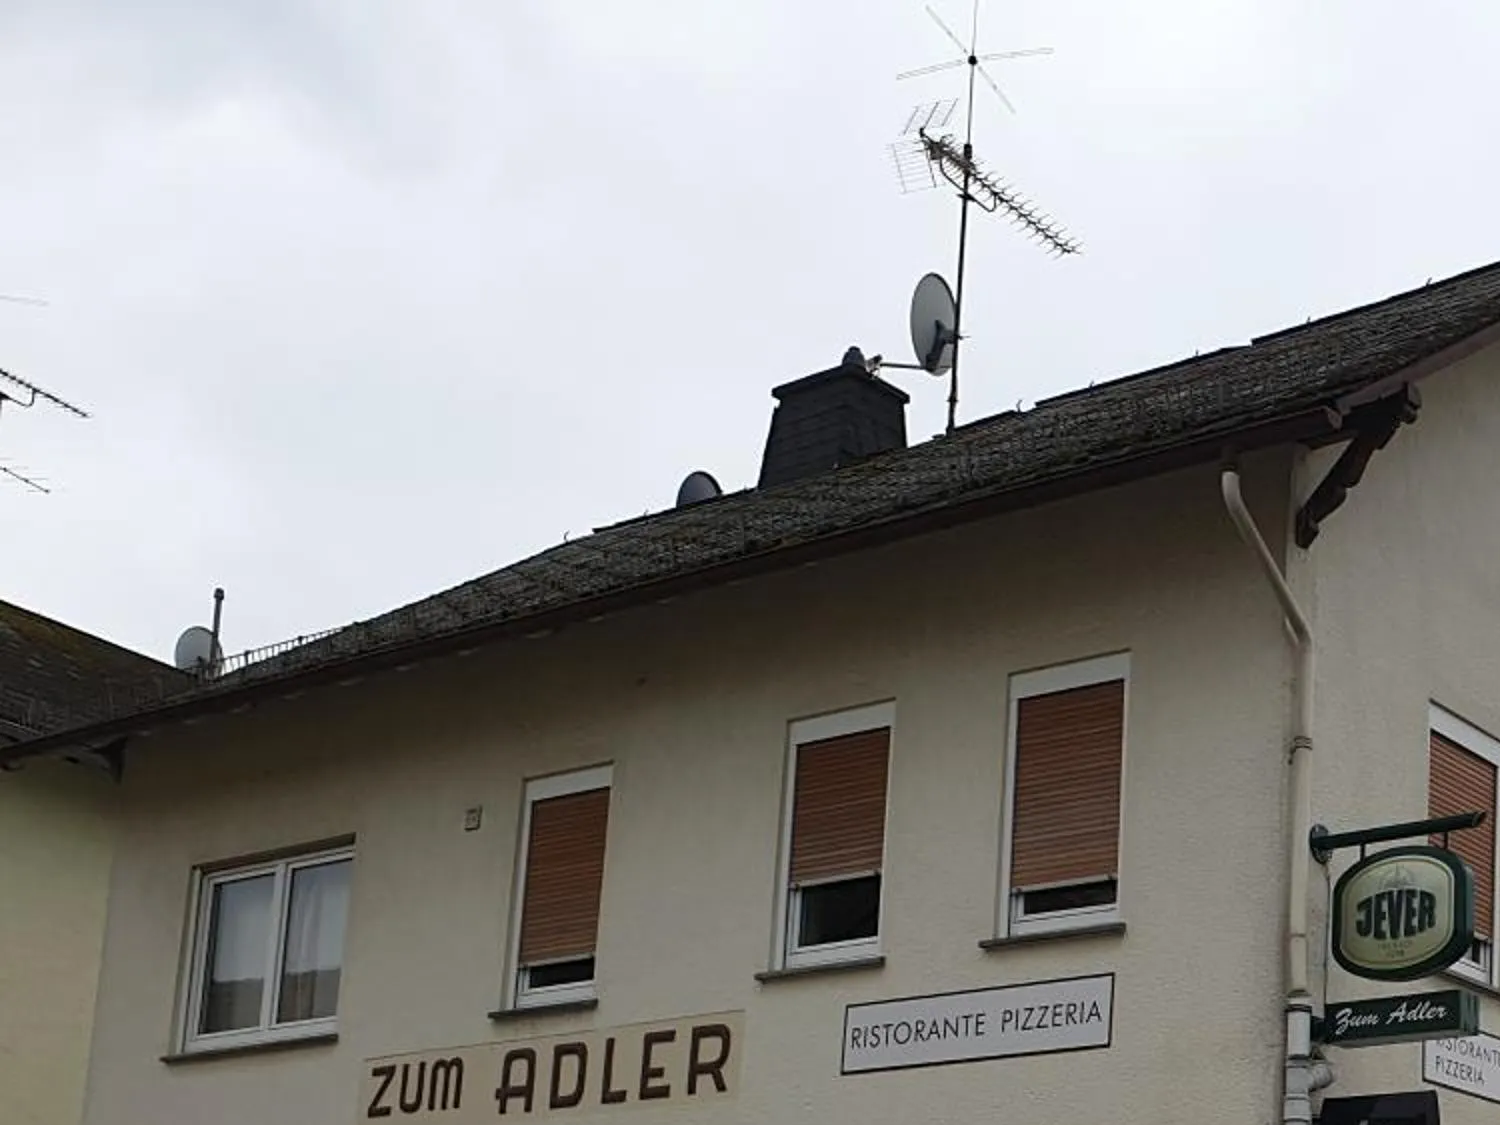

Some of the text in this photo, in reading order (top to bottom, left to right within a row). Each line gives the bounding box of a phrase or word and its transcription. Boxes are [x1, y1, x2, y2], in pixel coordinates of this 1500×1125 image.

[1355, 888, 1437, 940] JEVER
[851, 1001, 1103, 1050] RISTORANTE PIZZERIA
[1335, 1000, 1449, 1036] Zum Adler
[367, 1023, 732, 1119] ZUM ADLER
[1435, 1055, 1486, 1086] PIZZERIA
